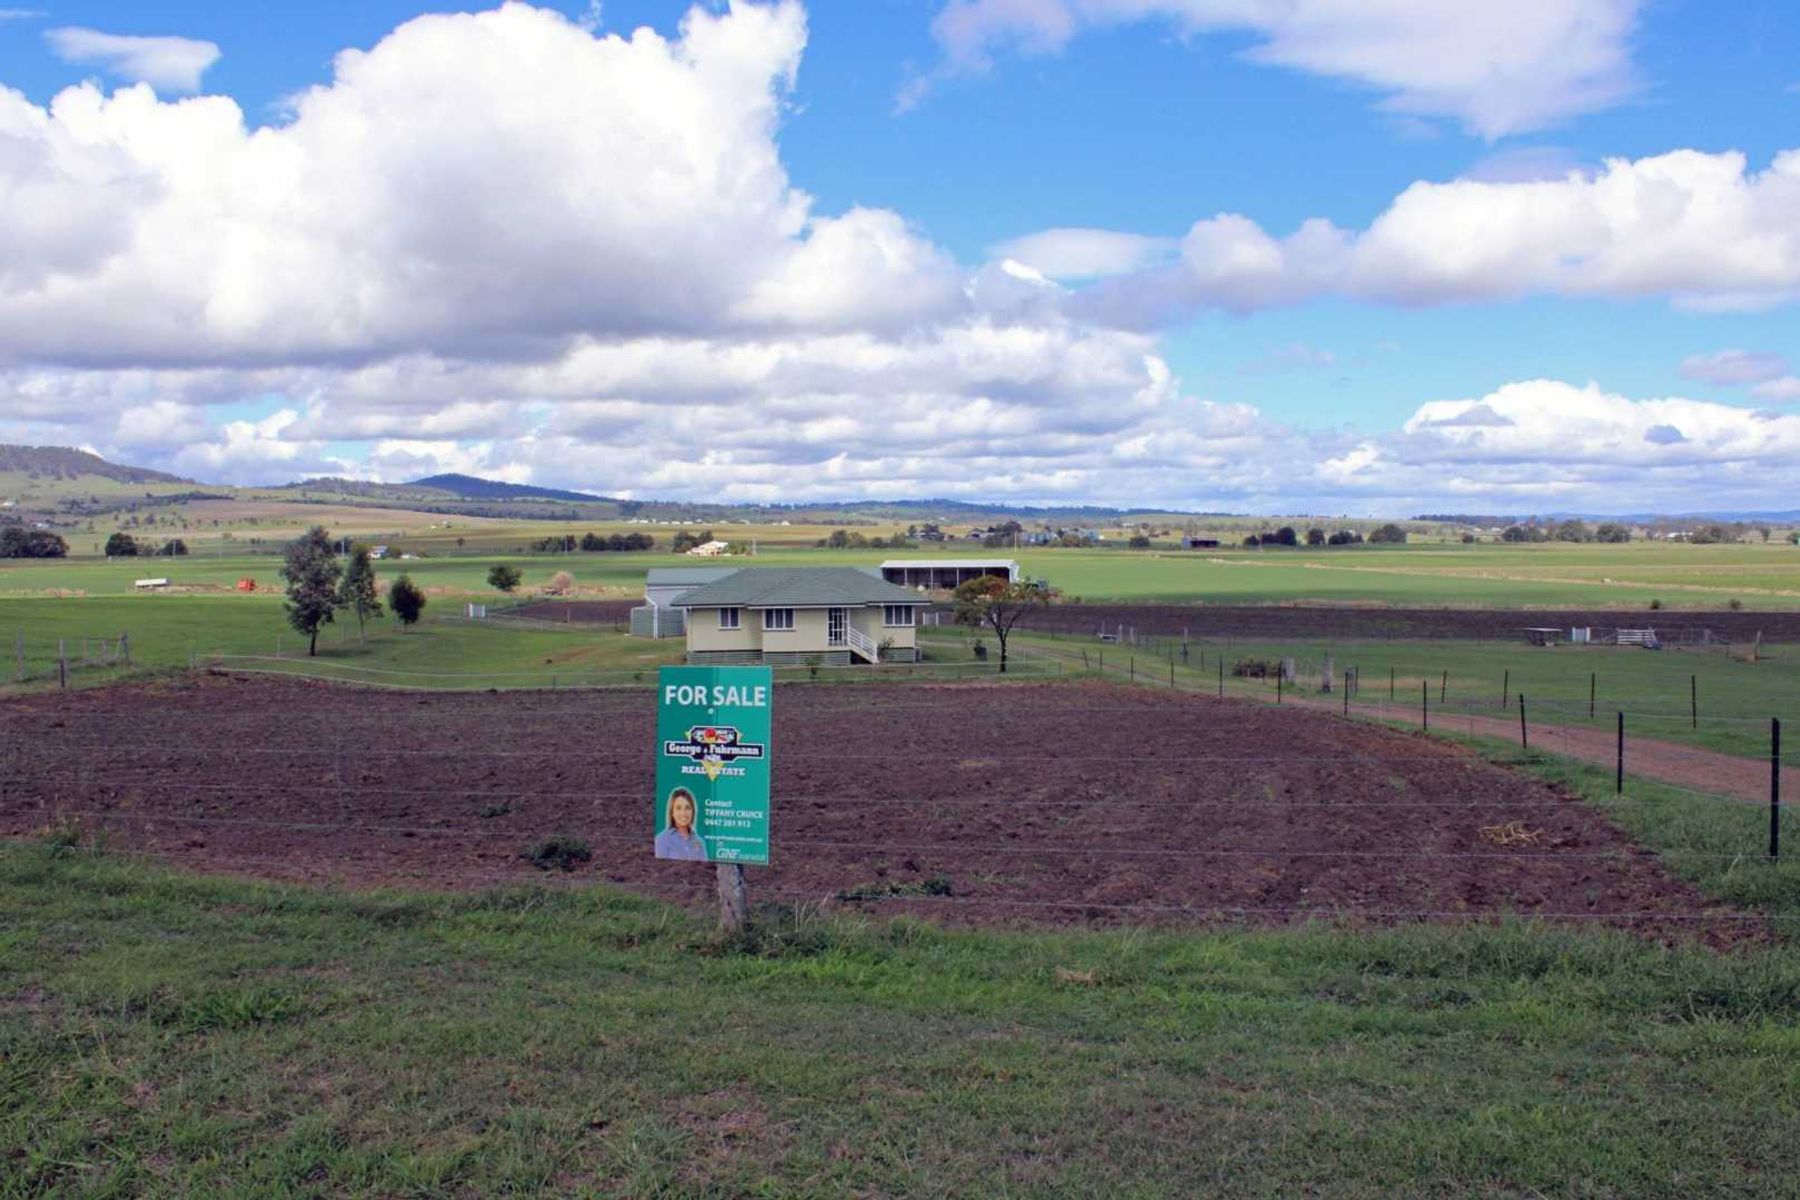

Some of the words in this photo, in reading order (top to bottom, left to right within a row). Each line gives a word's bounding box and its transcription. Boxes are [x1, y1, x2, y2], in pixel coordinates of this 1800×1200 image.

[665, 684, 707, 705] FOR
[712, 685, 766, 706] SALE
[669, 743, 701, 755] George
[709, 745, 759, 755] Fuhrmann
[681, 766, 706, 775] REAL
[705, 799, 732, 807] Contact
